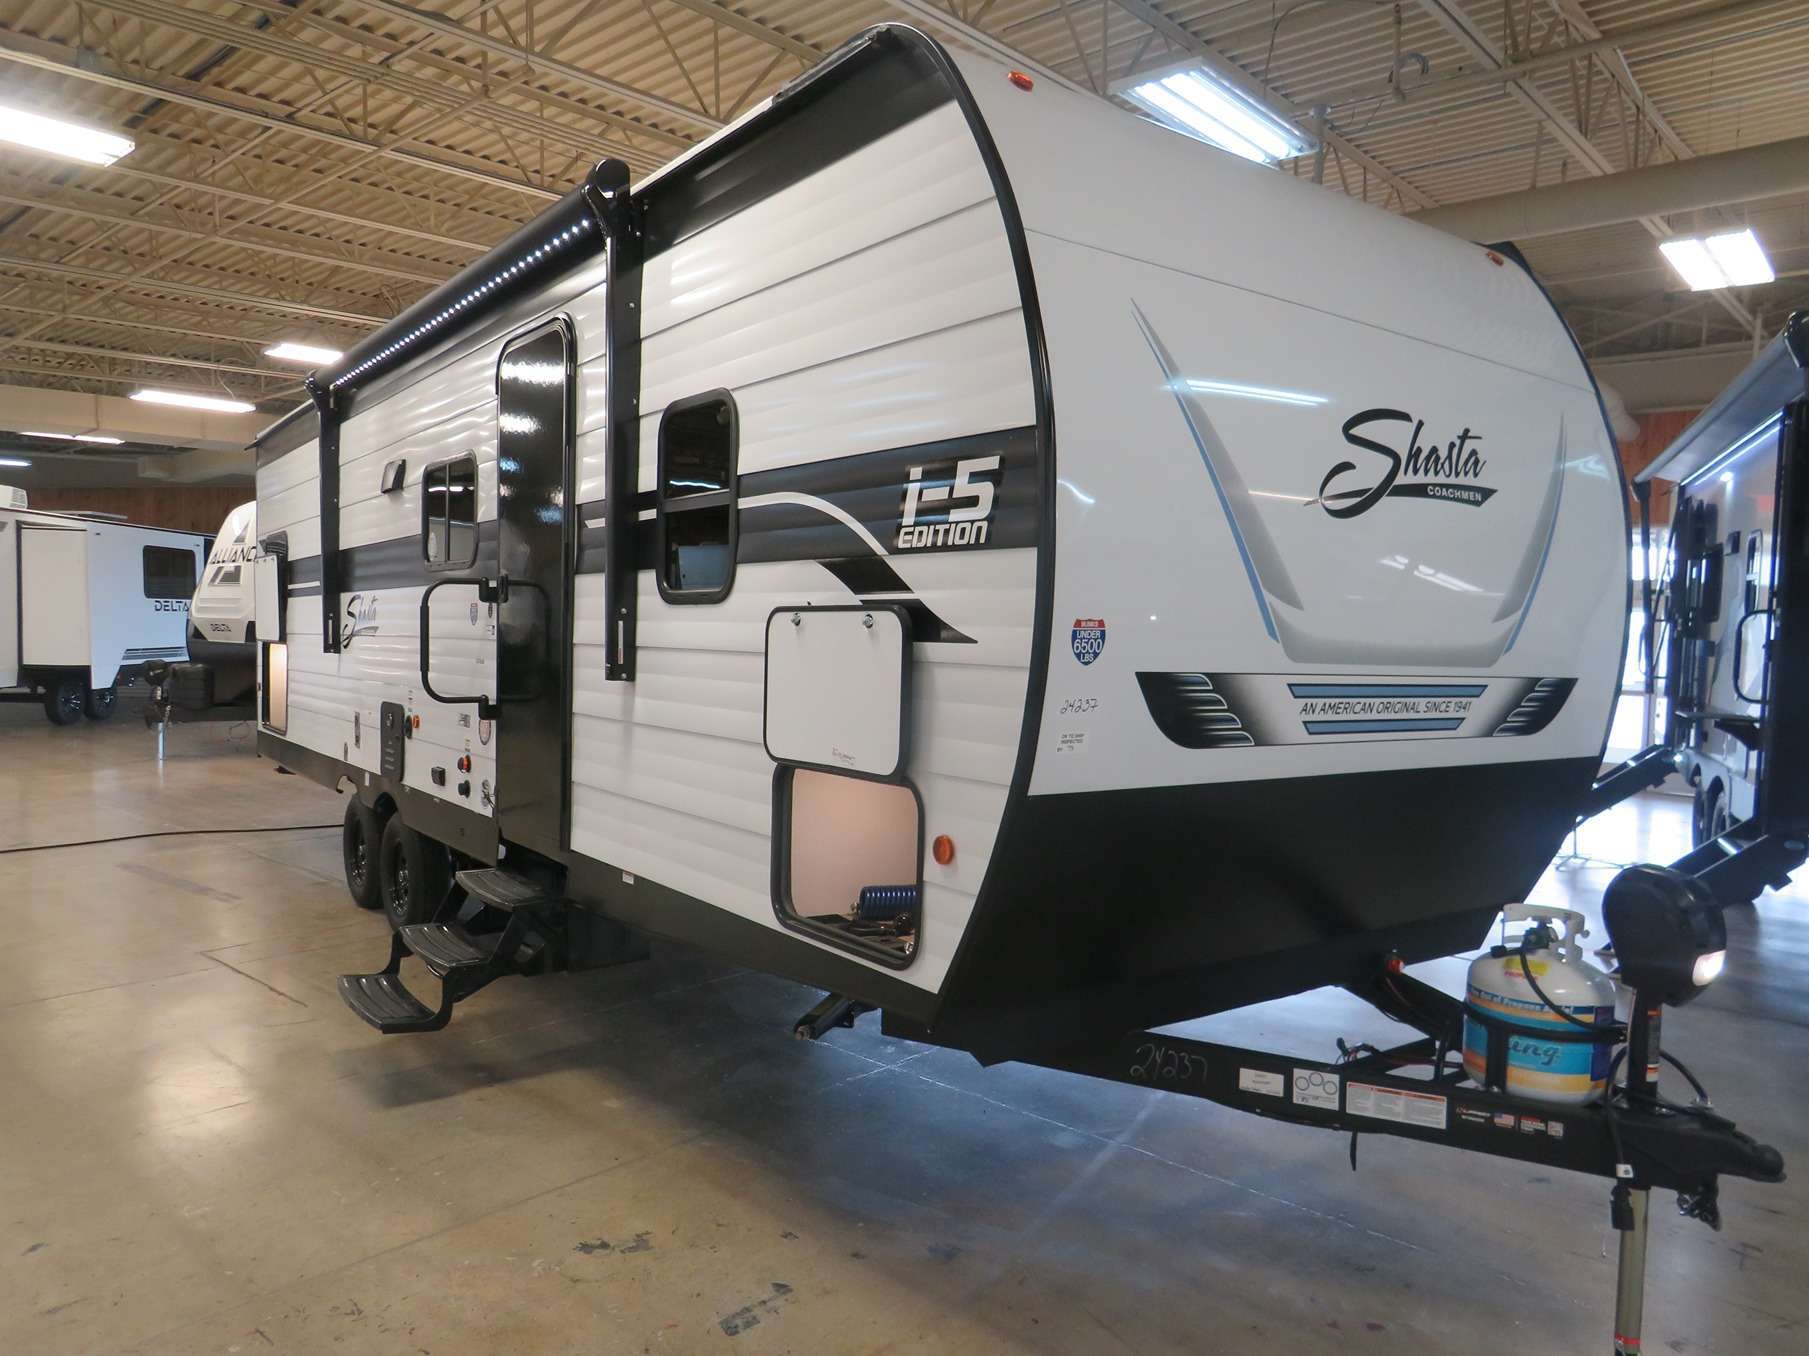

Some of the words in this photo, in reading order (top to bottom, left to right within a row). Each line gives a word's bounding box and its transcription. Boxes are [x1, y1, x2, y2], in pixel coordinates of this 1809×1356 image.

[1319, 408, 1486, 519] Shasta
[1427, 485, 1482, 502] COACHMEN
[897, 521, 988, 549] EDITION
[209, 545, 257, 564] ALLIANC
[154, 600, 190, 612] DELTA
[1076, 630, 1101, 639] UNDER
[1073, 639, 1103, 654] 6500
[1080, 653, 1094, 662] LBS
[1060, 698, 1099, 714] 24237
[1300, 702, 1318, 715] AN
[1318, 701, 1374, 715] AMERICAN
[1375, 701, 1421, 714] ORIGINAL
[1423, 701, 1450, 713] SINCE
[1453, 701, 1472, 713] 1941
[1130, 1043, 1208, 1083] 24237
